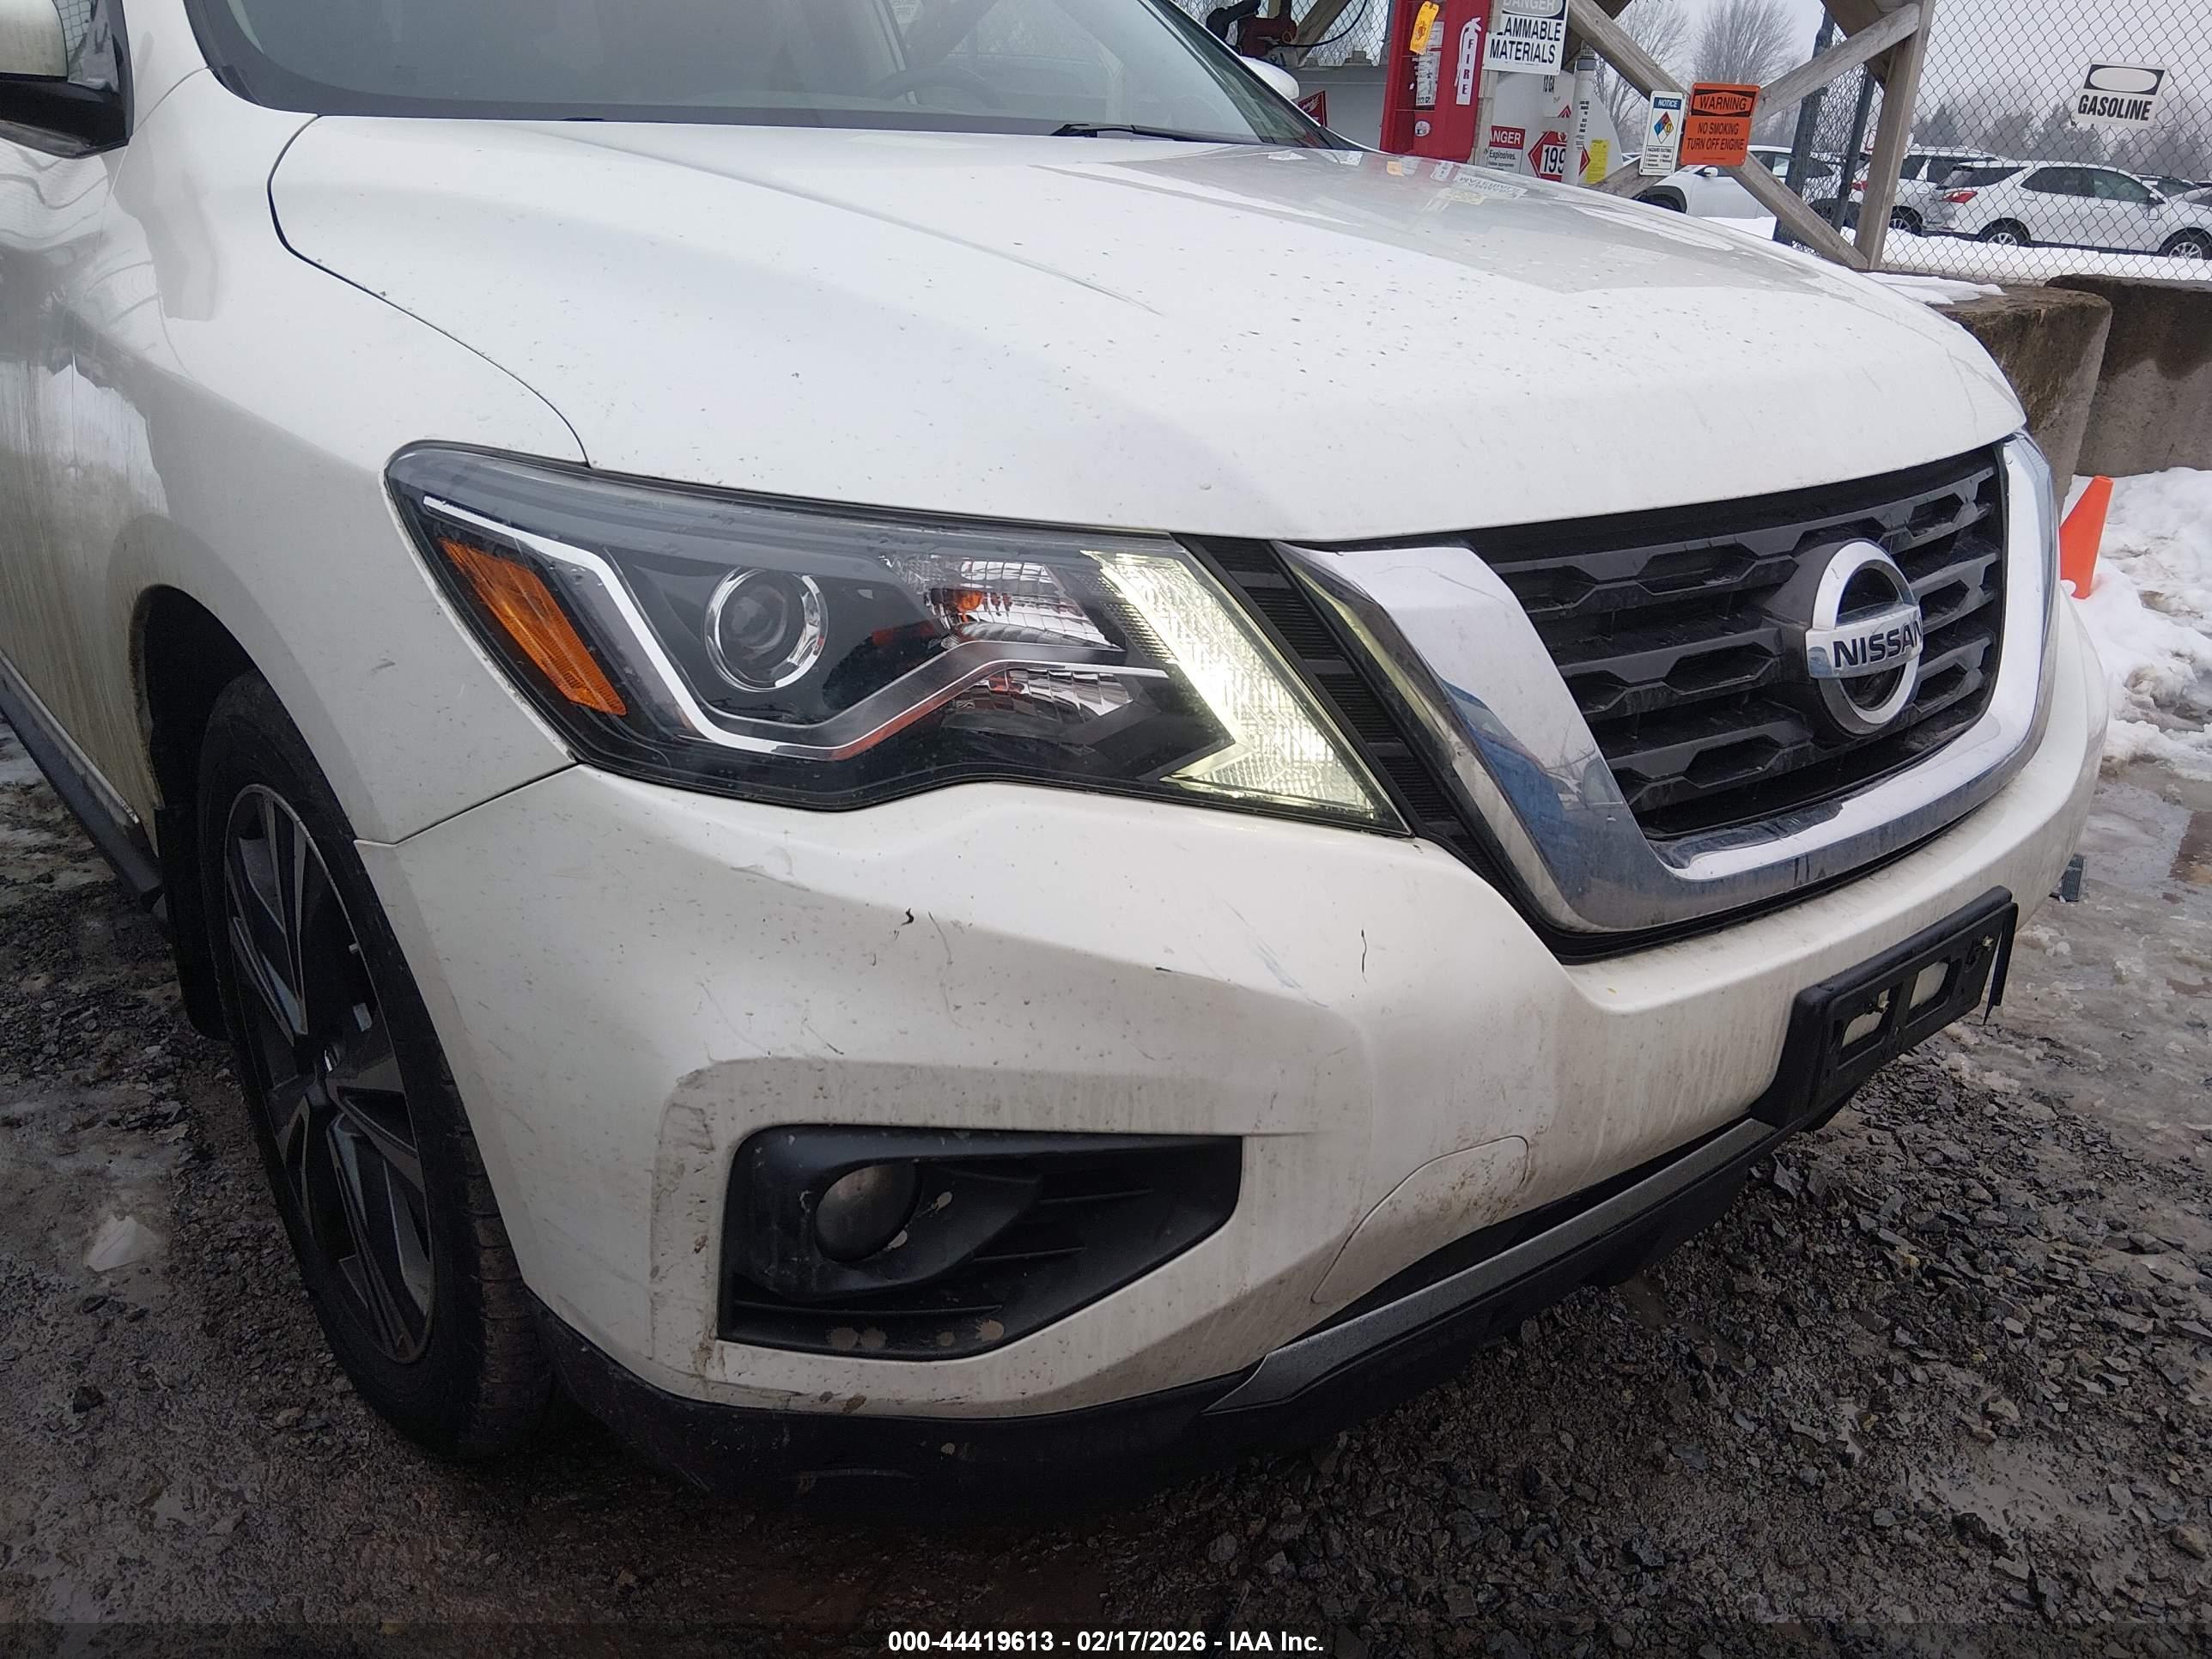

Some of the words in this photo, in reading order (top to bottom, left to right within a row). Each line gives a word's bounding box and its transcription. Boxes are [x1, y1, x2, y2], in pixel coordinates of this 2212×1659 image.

[1497, 17, 1562, 41] AMMABLE
[1490, 39, 1556, 64] MATERIALS
[1462, 39, 1474, 94] FIRE
[1657, 99, 1678, 108] NOTICE
[1700, 95, 1747, 111] WARNING
[2078, 94, 2153, 121] GASOLINE
[1697, 122, 1708, 134] NO
[1709, 123, 1740, 135] SMOKING
[1686, 138, 1706, 150] TURN
[1706, 138, 1720, 150] OFF
[1720, 138, 1745, 150] ENGINE
[1544, 146, 1566, 173] 199
[1832, 615, 1923, 668] NISSAN
